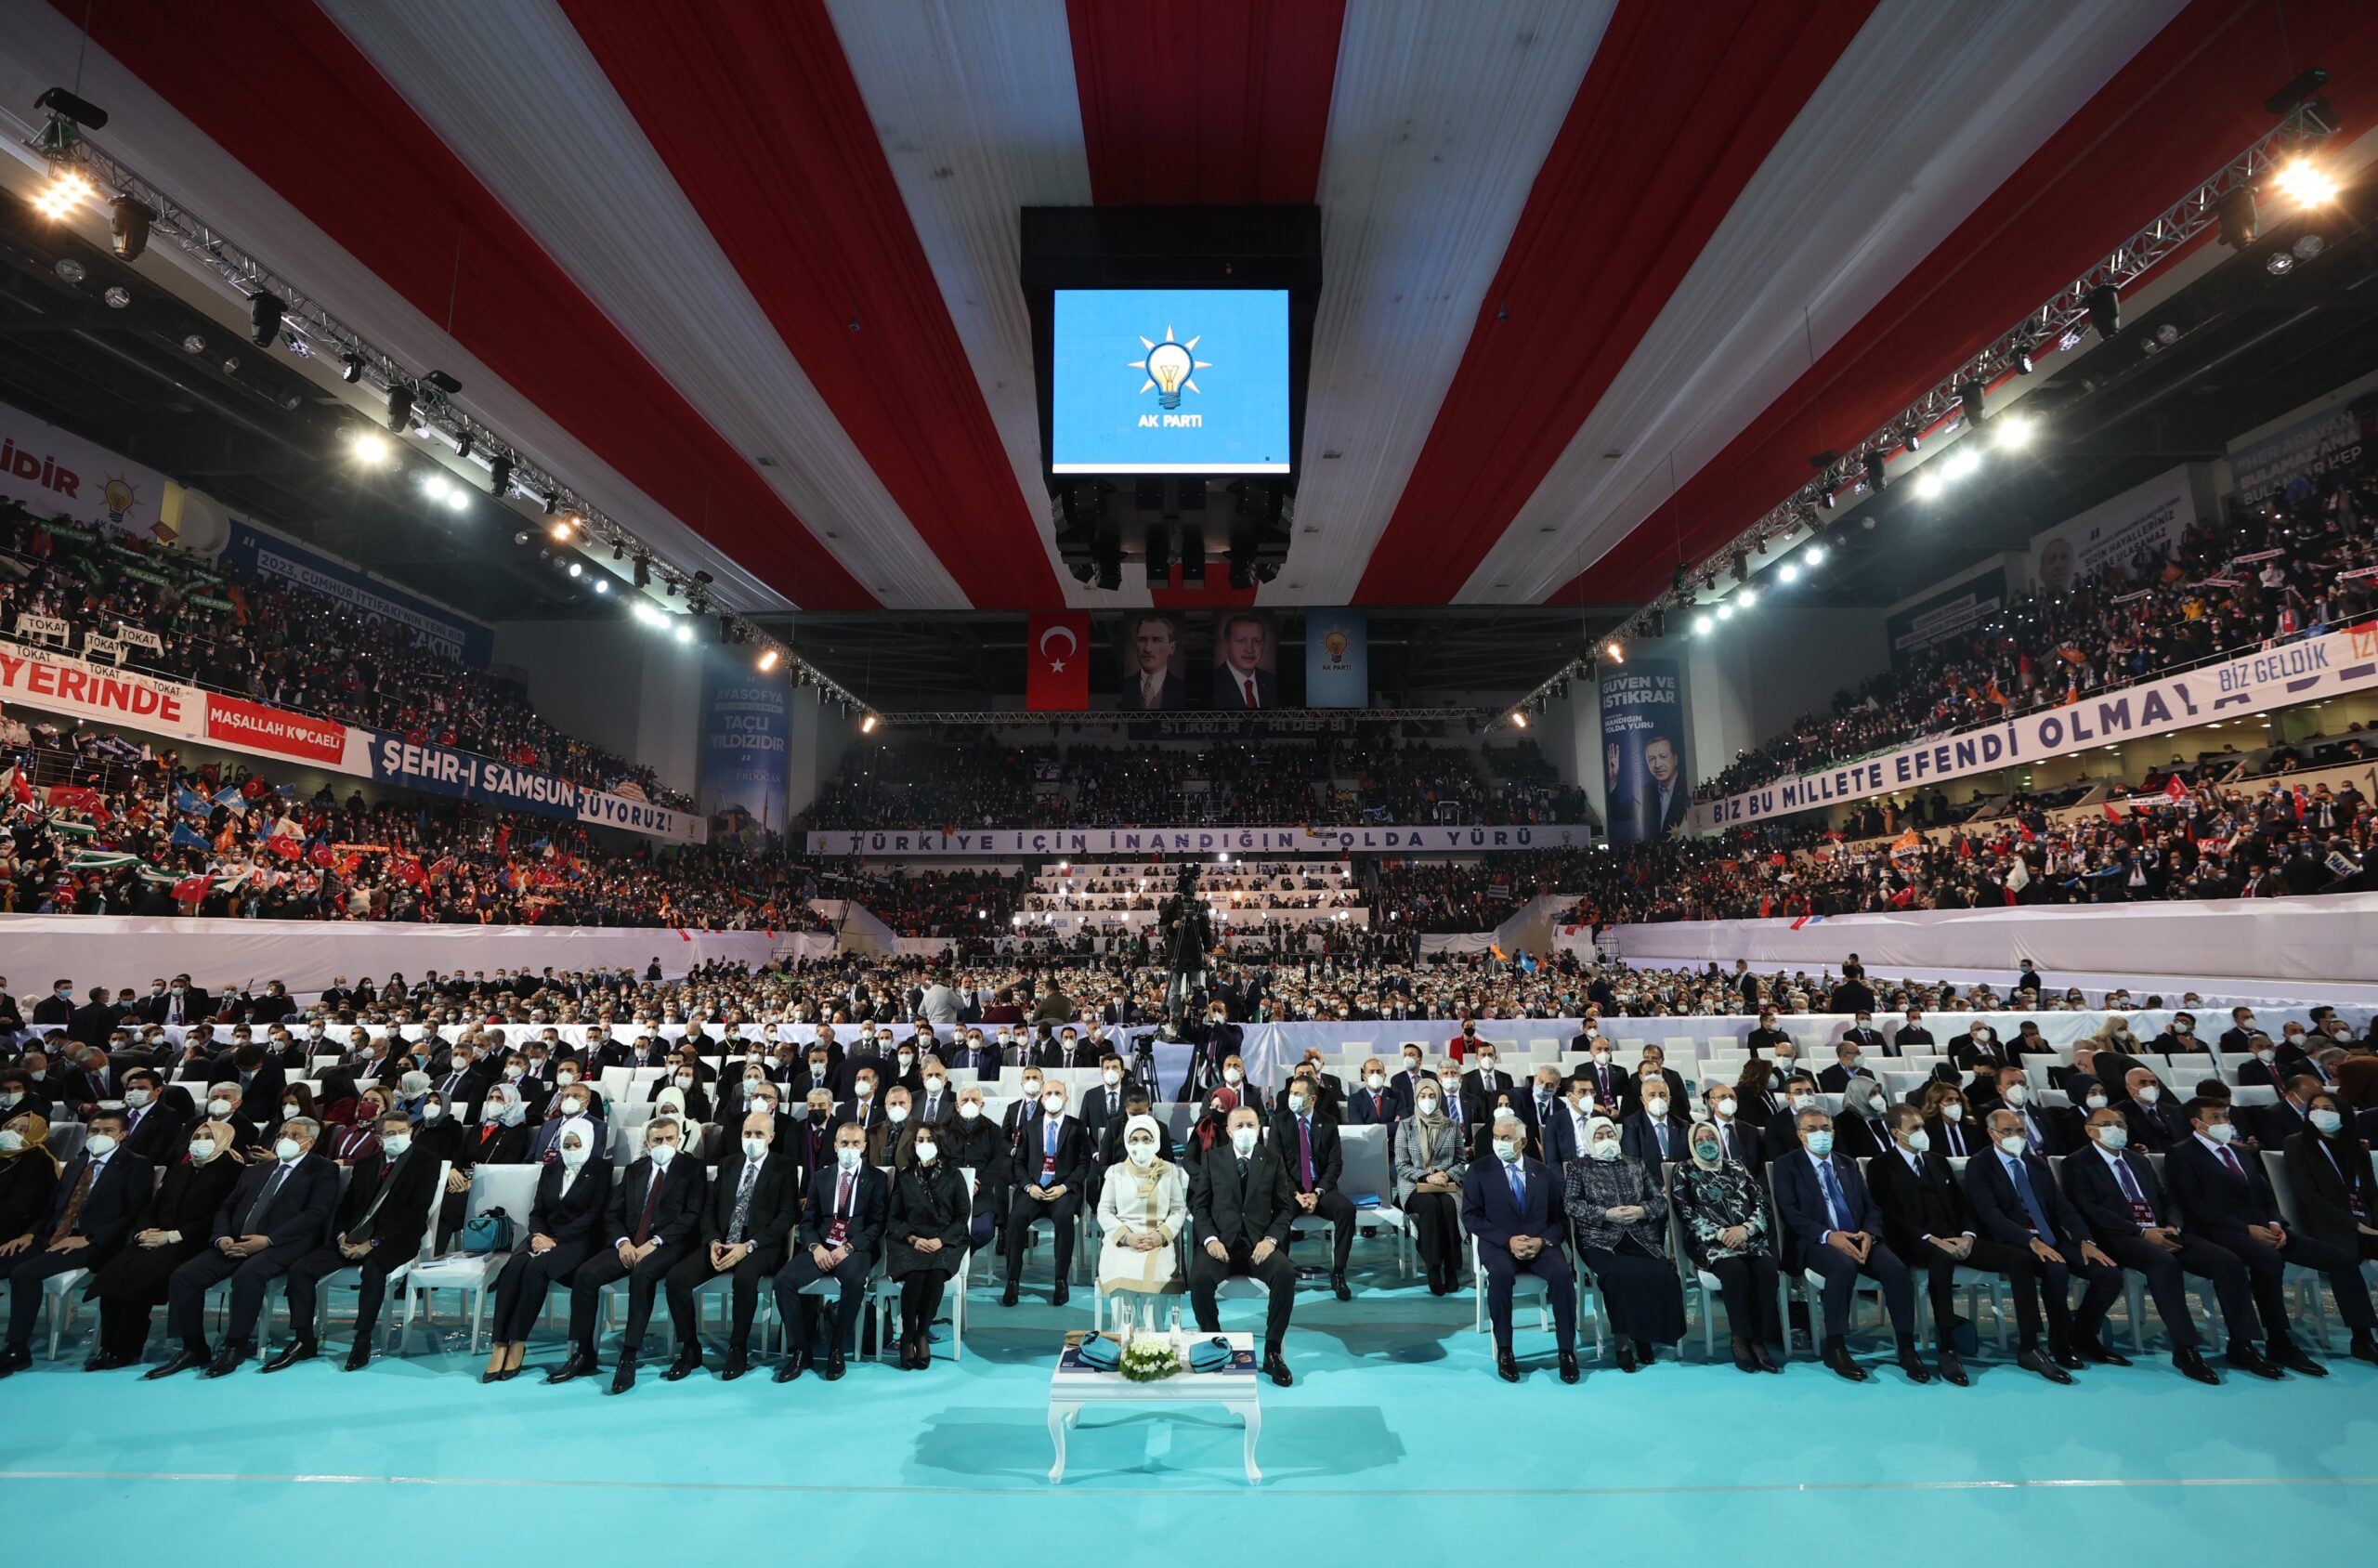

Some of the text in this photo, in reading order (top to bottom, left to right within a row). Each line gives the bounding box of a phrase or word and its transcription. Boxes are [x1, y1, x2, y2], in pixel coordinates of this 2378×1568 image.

[1138, 414, 1159, 427] AK
[2240, 429, 2361, 490] BULAMAZ AMA
[2329, 446, 2362, 470] HEP
[302, 570, 353, 600] CUMHUR
[27, 618, 67, 633] TOKAT
[88, 634, 120, 651] TOKAT
[122, 629, 157, 646] TOKAT
[16, 645, 52, 663] TOKAT
[89, 663, 121, 680] TOKAT
[2219, 667, 2251, 693] BİZ
[2254, 642, 2330, 683] GELDİK
[152, 680, 181, 697] TOKAT
[1654, 676, 1676, 688] VE
[716, 688, 783, 704] AYASOFYA
[210, 707, 284, 737] MAŞALLAH
[724, 715, 769, 733] TAÇLI
[711, 733, 784, 752] YILDIZIDIR
[1714, 799, 1742, 823] BİZ
[1749, 791, 1773, 816] BU
[1783, 763, 1883, 807] MİLLETE
[1897, 721, 2019, 782] EFENDİ
[482, 764, 575, 808] SAMSUN
[850, 830, 993, 851] TÜRKİYE
[1016, 830, 1086, 854] İÇİN
[1110, 829, 1293, 850] İNANDIĞIN
[1320, 830, 1423, 848] OLDA
[1447, 829, 1531, 846] YÜRÜ
